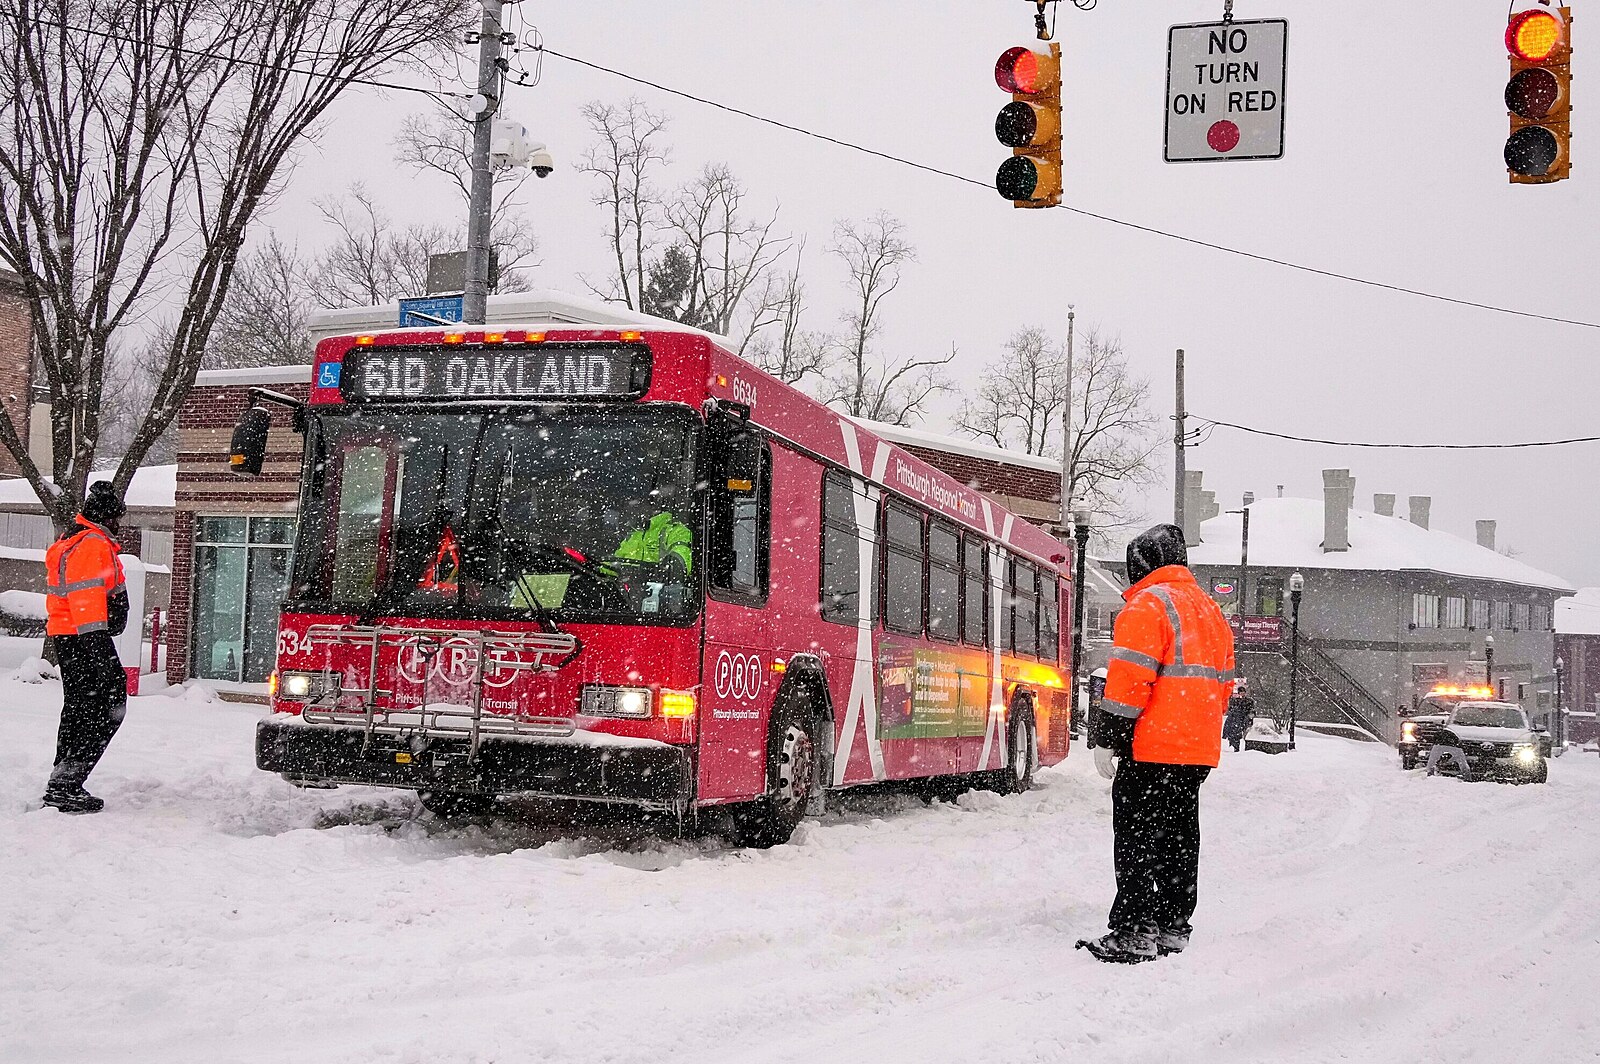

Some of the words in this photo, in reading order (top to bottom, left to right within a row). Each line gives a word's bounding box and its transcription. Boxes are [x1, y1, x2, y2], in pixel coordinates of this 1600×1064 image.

[1208, 28, 1248, 55] NO
[1194, 61, 1259, 85] TURN
[1173, 93, 1206, 115] ON
[1228, 90, 1277, 112] RED
[445, 310, 457, 322] St
[364, 356, 427, 396] 61D
[444, 355, 611, 394] OAKLAND
[733, 376, 757, 409] 6634
[896, 457, 932, 501] Pittsburgh
[931, 476, 958, 510] Regional
[957, 491, 977, 520] Transit
[1261, 621, 1280, 630] Therapy
[407, 643, 510, 679] PRT
[718, 659, 759, 691] PRT
[486, 697, 519, 710] Transit
